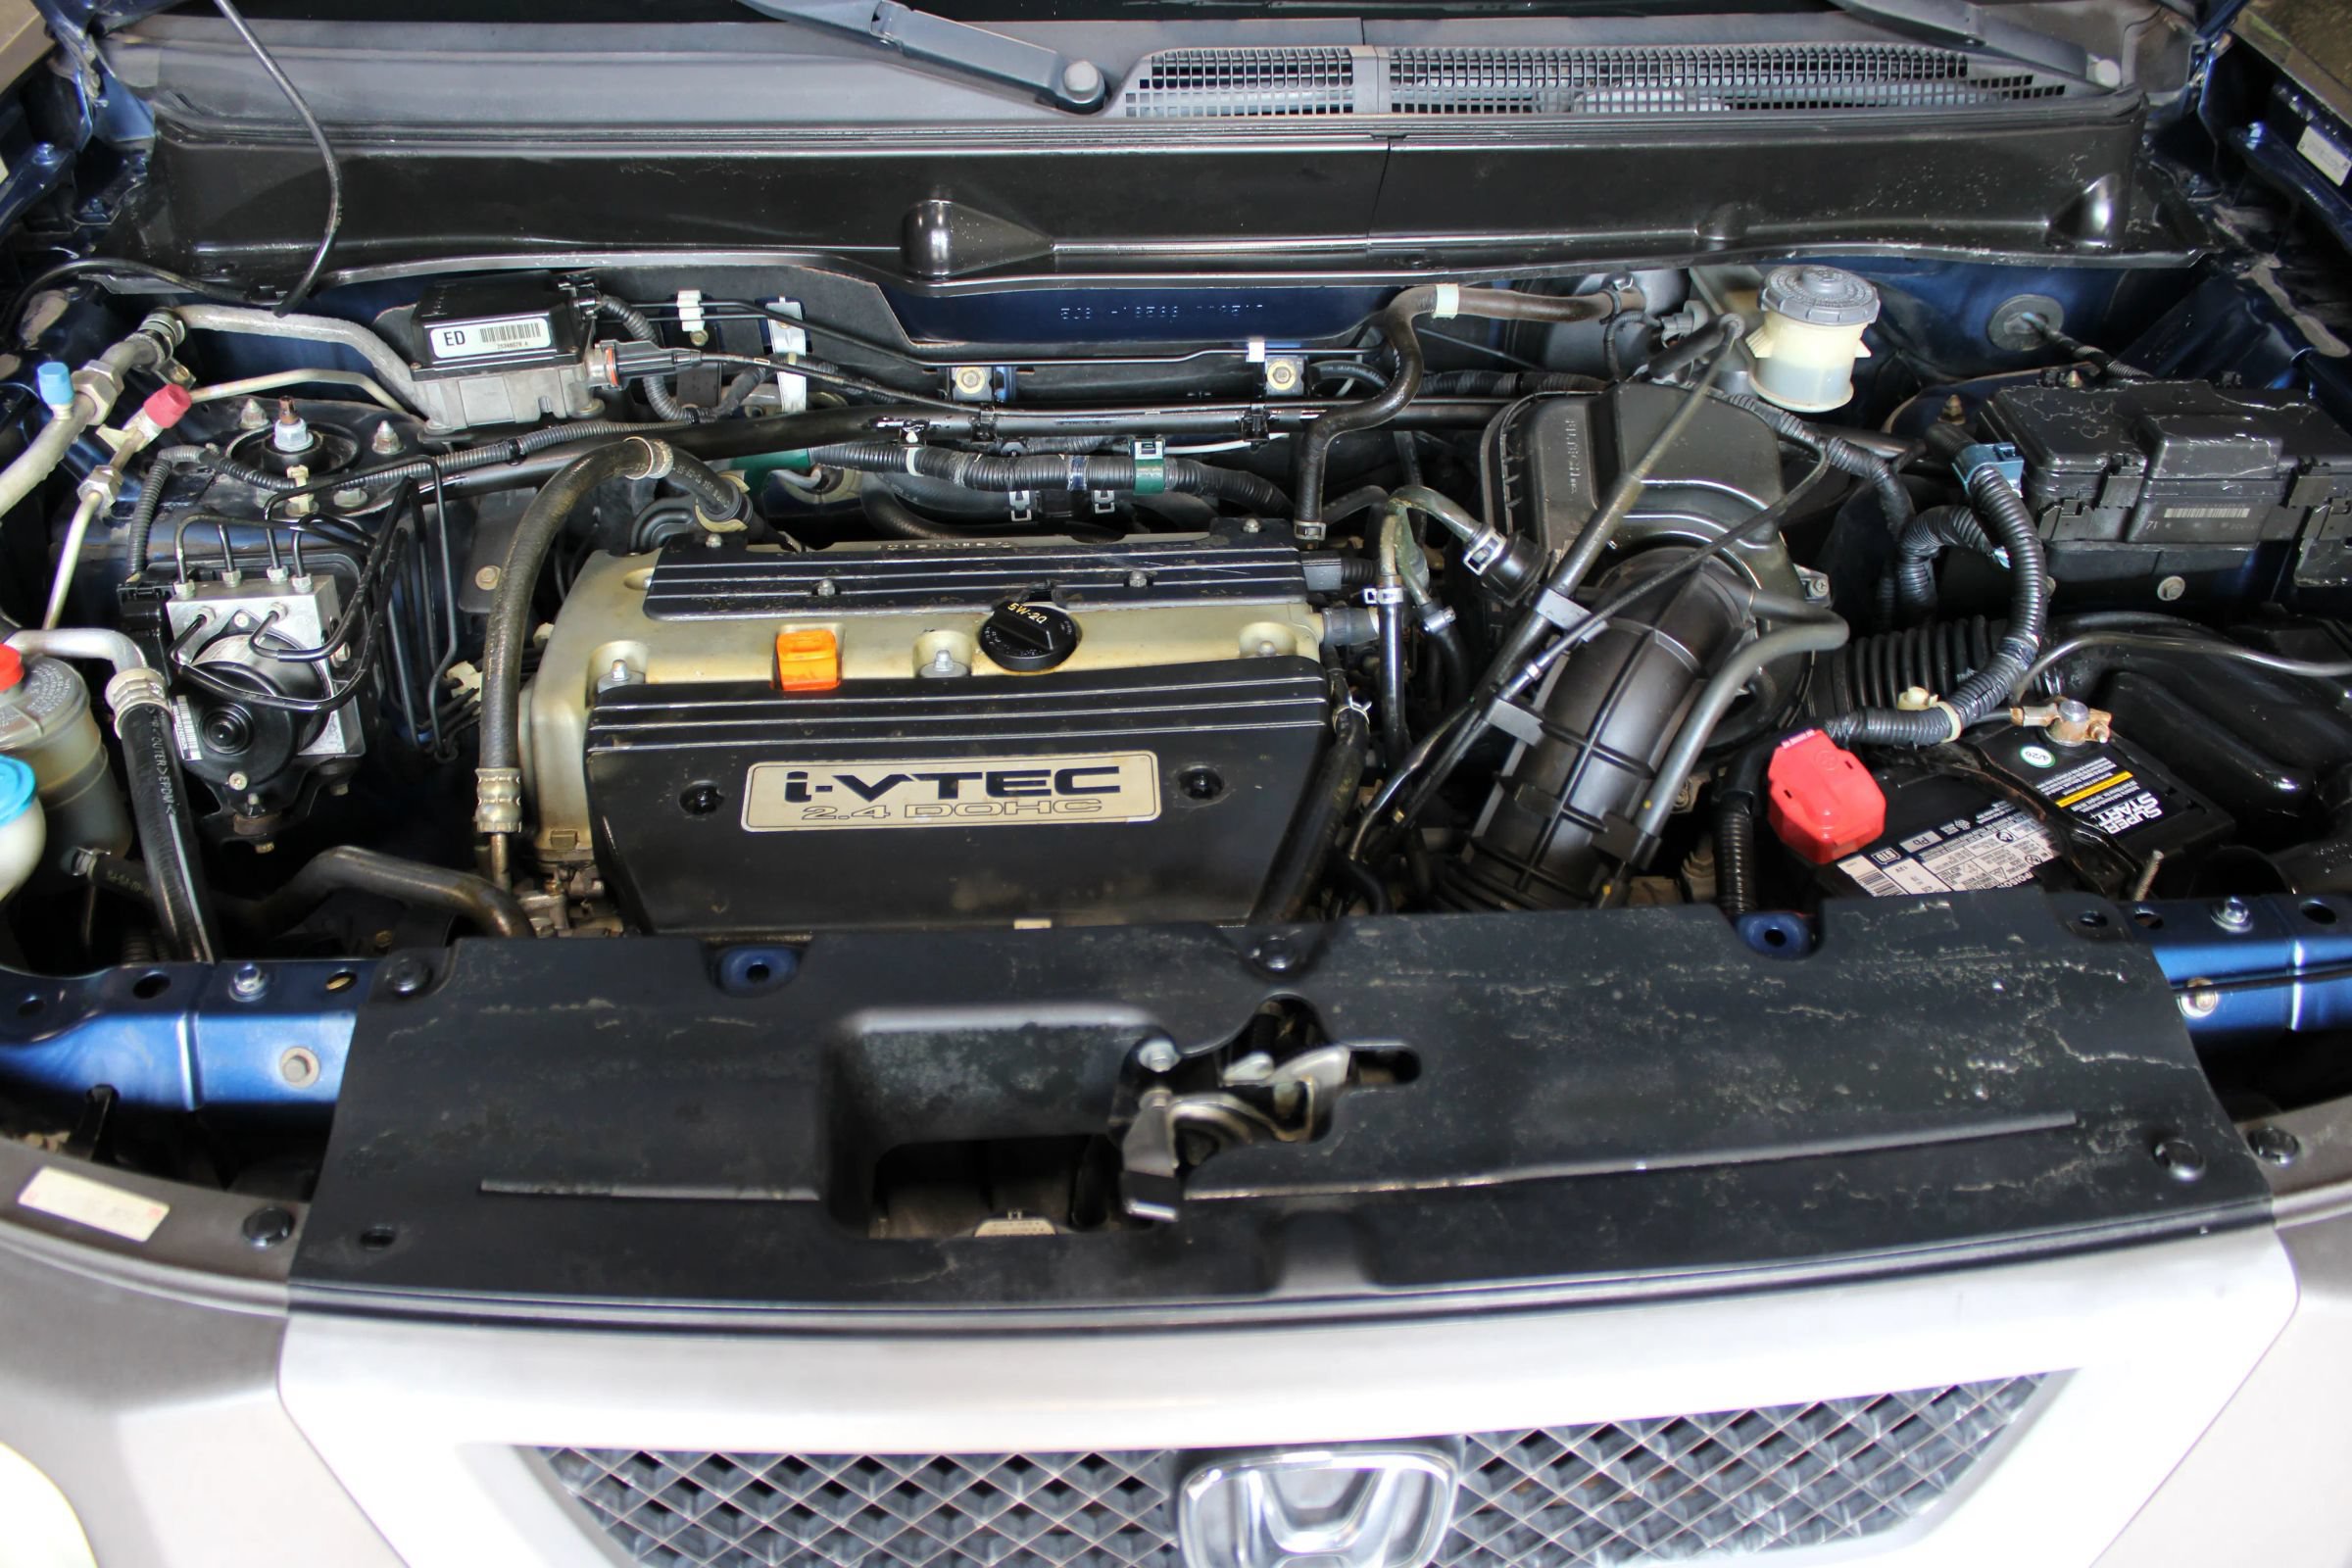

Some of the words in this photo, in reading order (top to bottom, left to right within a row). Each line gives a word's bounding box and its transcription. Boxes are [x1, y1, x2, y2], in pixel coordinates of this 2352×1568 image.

[443, 329, 466, 347] ED
[1007, 602, 1048, 624] 5W-20
[785, 765, 1121, 804] i-VTEC
[801, 804, 891, 821] 2.4
[904, 798, 1103, 819] DOHC
[2094, 791, 2160, 827] START
[2105, 806, 2164, 834] SUPER
[1912, 836, 1931, 846] Pb
